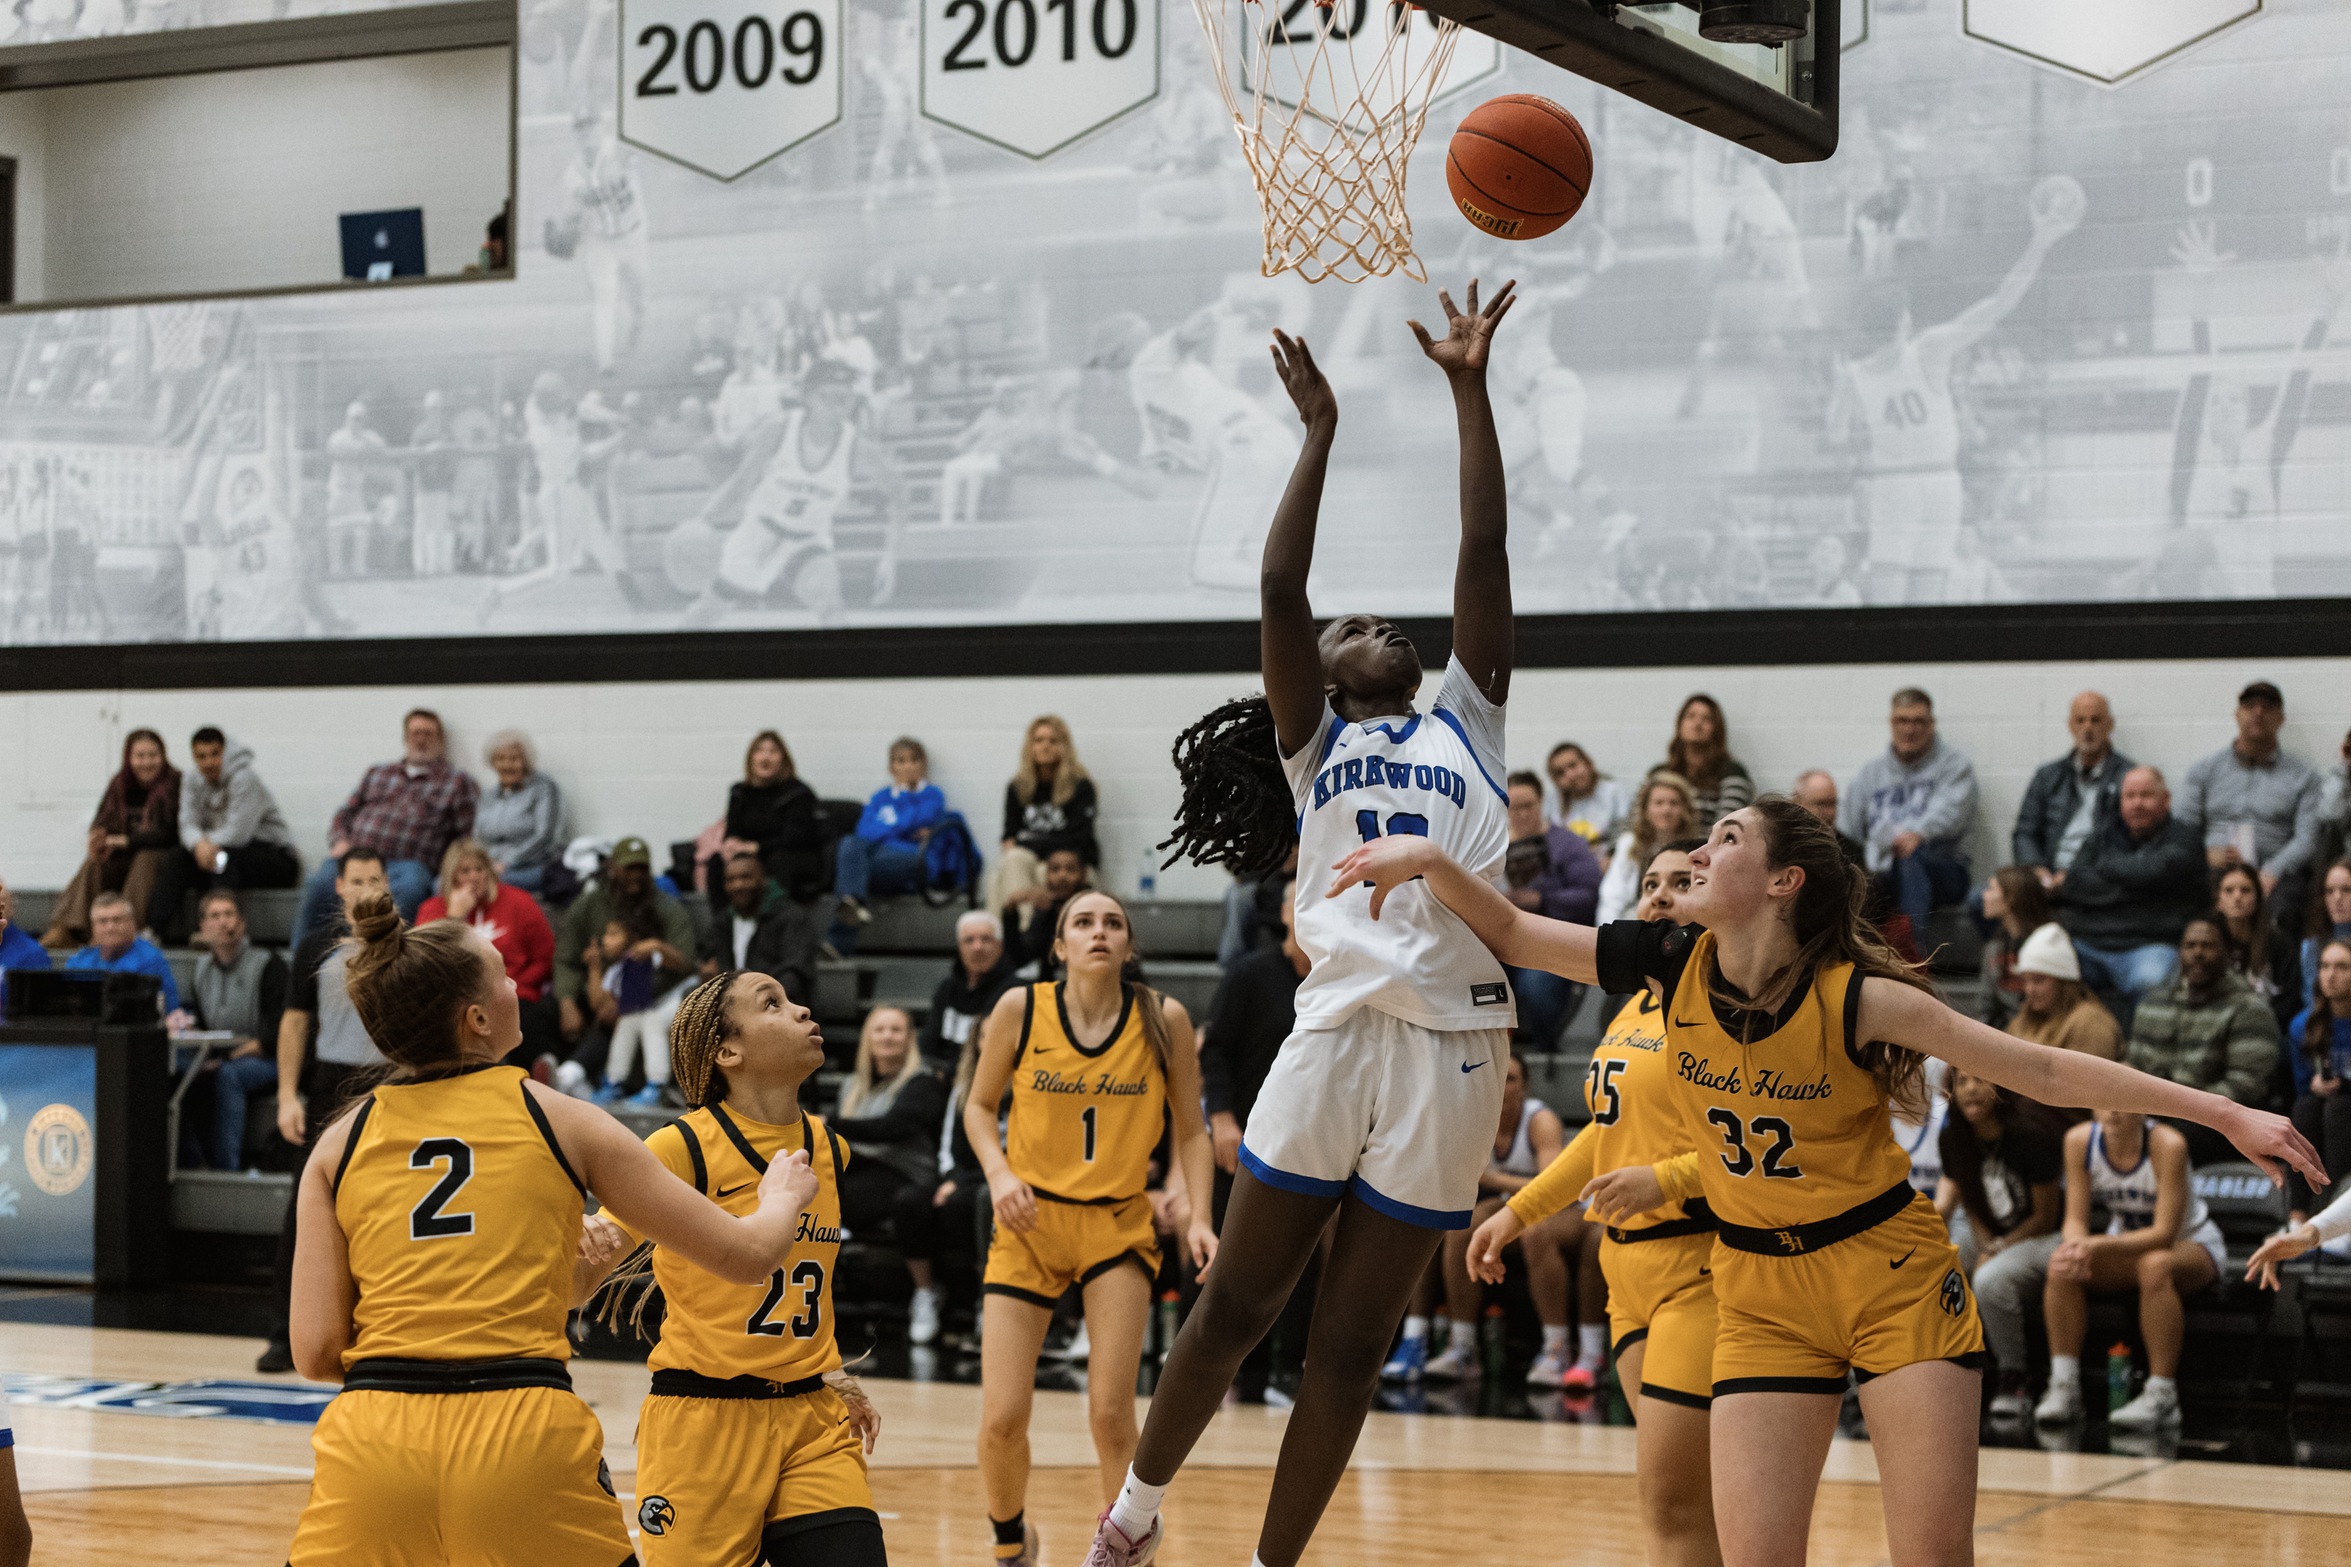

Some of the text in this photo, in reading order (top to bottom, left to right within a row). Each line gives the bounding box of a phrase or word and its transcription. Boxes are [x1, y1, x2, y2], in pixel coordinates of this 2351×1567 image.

[635, 11, 824, 97] 2009
[943, 0, 1136, 71] 2010
[1313, 755, 1466, 812] KIRKWOOD
[1032, 1069, 1149, 1096] Black Hawk
[1677, 1051, 1832, 1100] Black Hawk
[1082, 1106, 1096, 1164] 1
[1706, 1106, 1807, 1179] 32
[408, 1137, 475, 1241] 2
[746, 1260, 825, 1339] 23
